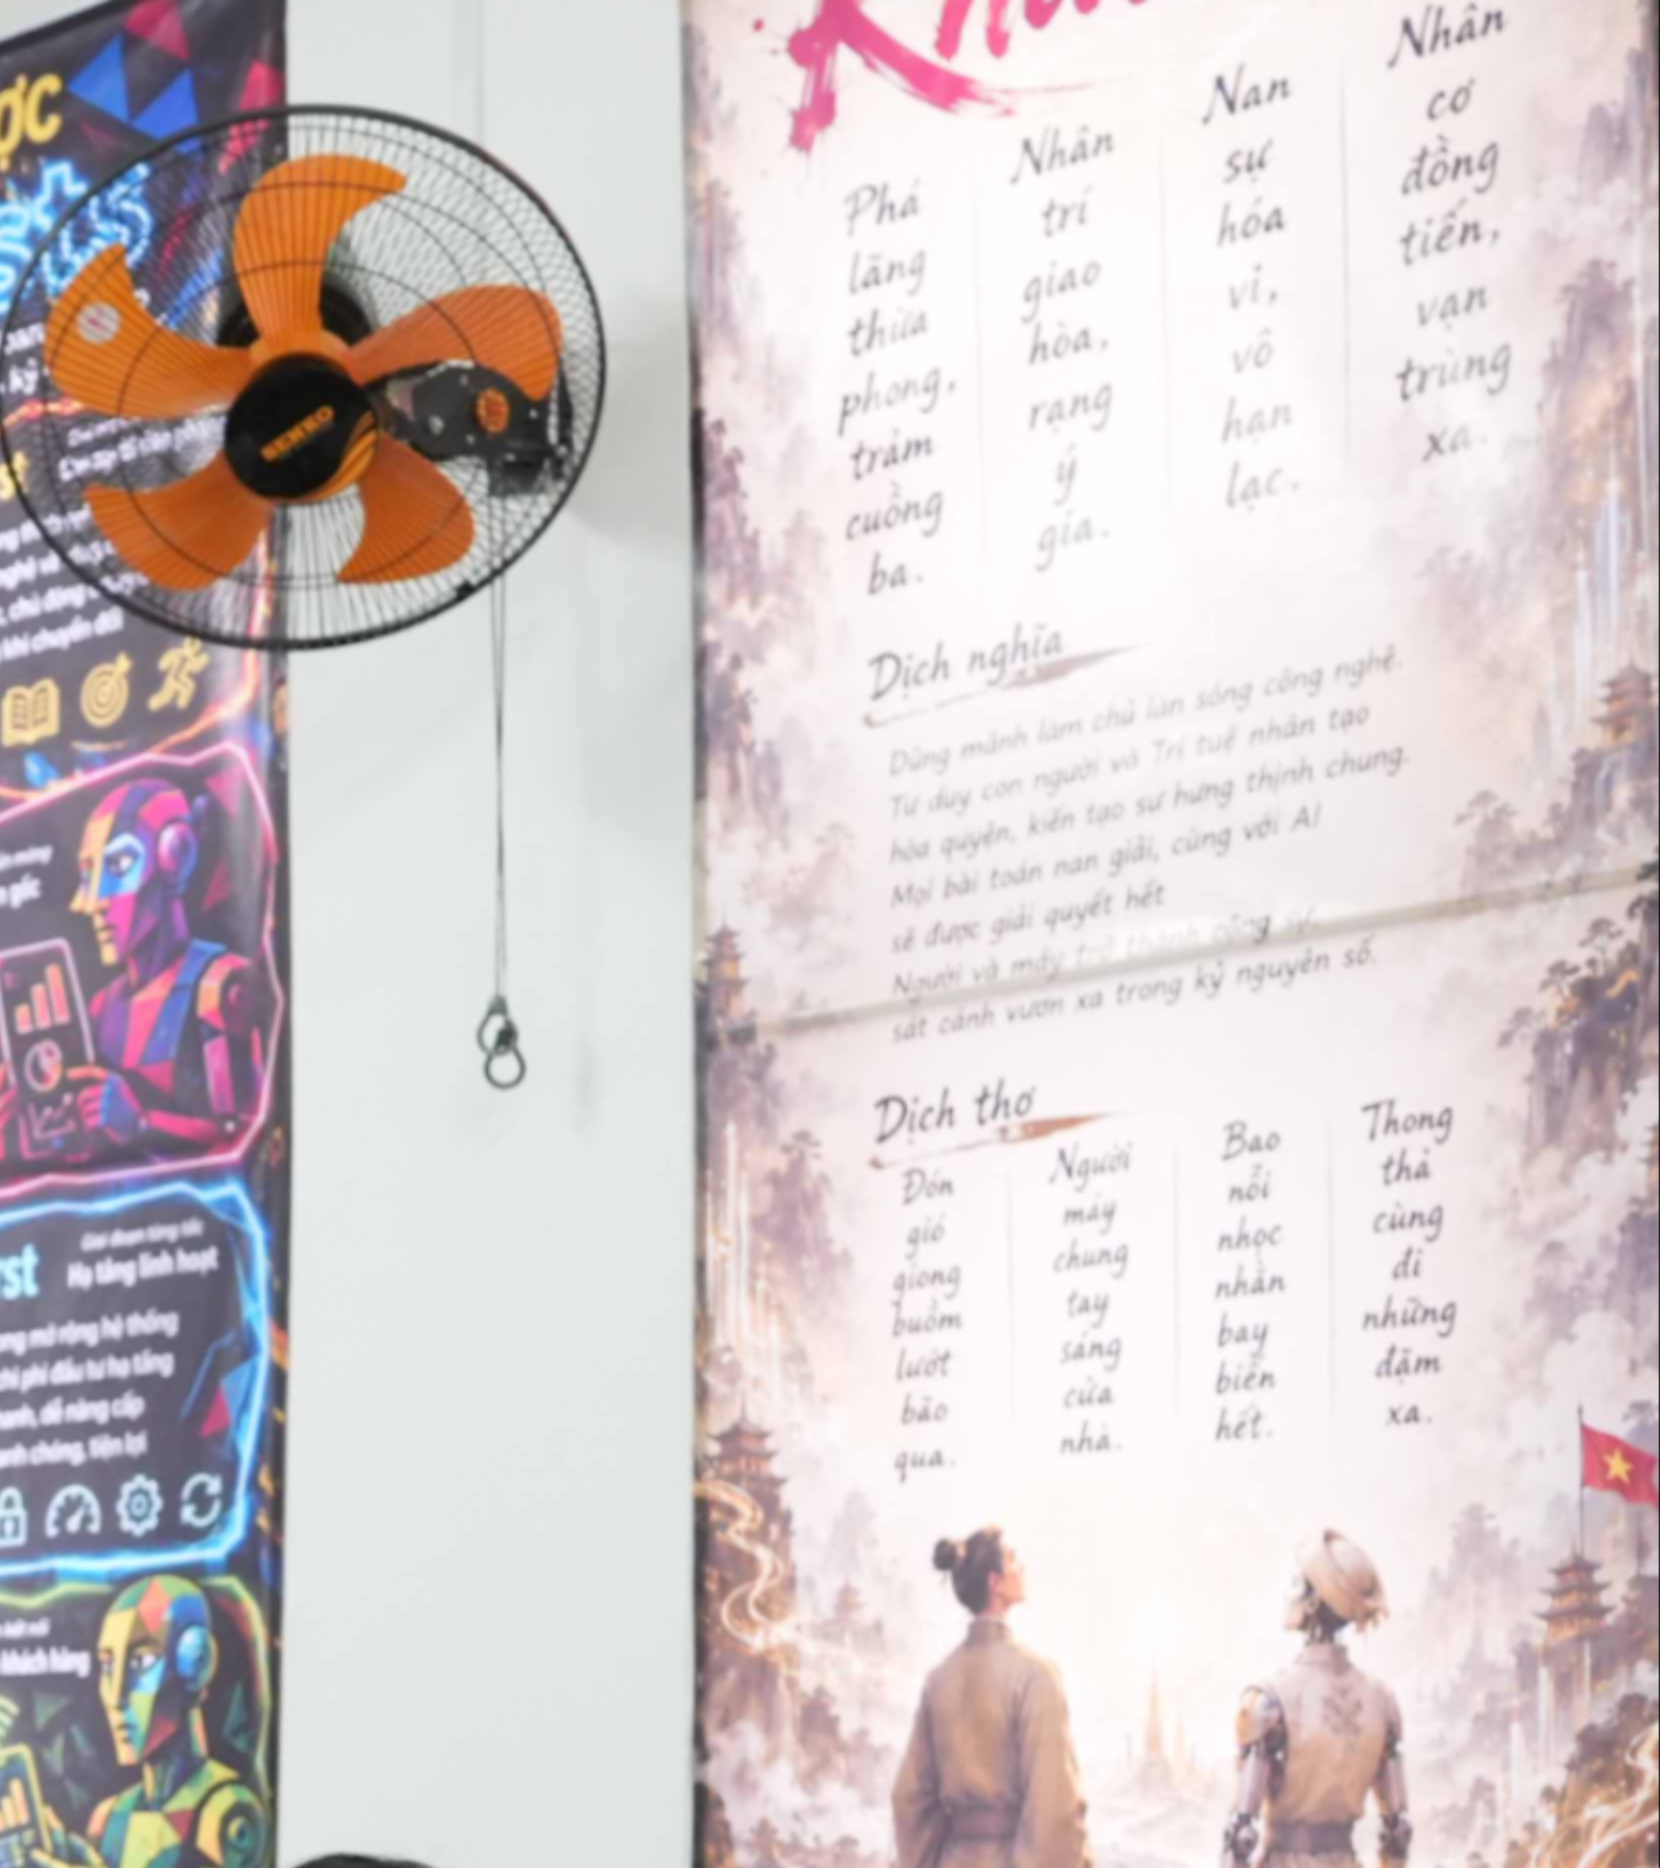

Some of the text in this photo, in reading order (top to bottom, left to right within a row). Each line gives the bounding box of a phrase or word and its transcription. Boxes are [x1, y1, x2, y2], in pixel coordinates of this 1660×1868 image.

[1202, 62, 1291, 125] Nan
[1426, 77, 1476, 121] cơ
[1011, 125, 1115, 185] Nhân
[1224, 138, 1274, 185] sự
[1400, 134, 1501, 197] đồng
[844, 178, 921, 236] Phá
[1040, 185, 1095, 239] trí
[1217, 196, 1285, 248] hóa
[1399, 196, 1501, 267] tiến,
[848, 250, 927, 296] lãng
[1023, 259, 1103, 325] giao
[1417, 286, 1488, 332] vạn
[1028, 322, 1109, 367] hòa,
[1232, 327, 1275, 374] vô
[1396, 342, 1512, 404] trùng
[837, 367, 956, 438] phong,
[1029, 382, 1113, 434] rạng
[845, 480, 944, 540] cuồng
[868, 551, 924, 596] ba.
[868, 620, 1065, 702] Dịch nghĩa
[874, 1076, 1039, 1150] Dịch thơ
[1361, 1098, 1455, 1145] Thong
[1220, 1119, 1283, 1162] Bao
[903, 1167, 955, 1206] Đón
[1380, 1147, 1433, 1187] thả
[904, 1212, 947, 1261] gió
[1063, 1191, 1117, 1236] máy
[1372, 1200, 1444, 1244] cùng
[1052, 1238, 1130, 1280] chung
[1392, 1246, 1424, 1281] đi
[1067, 1289, 1110, 1330] tay
[1362, 1294, 1458, 1340] những
[1060, 1331, 1123, 1374] sáng
[1217, 1311, 1270, 1357] bay
